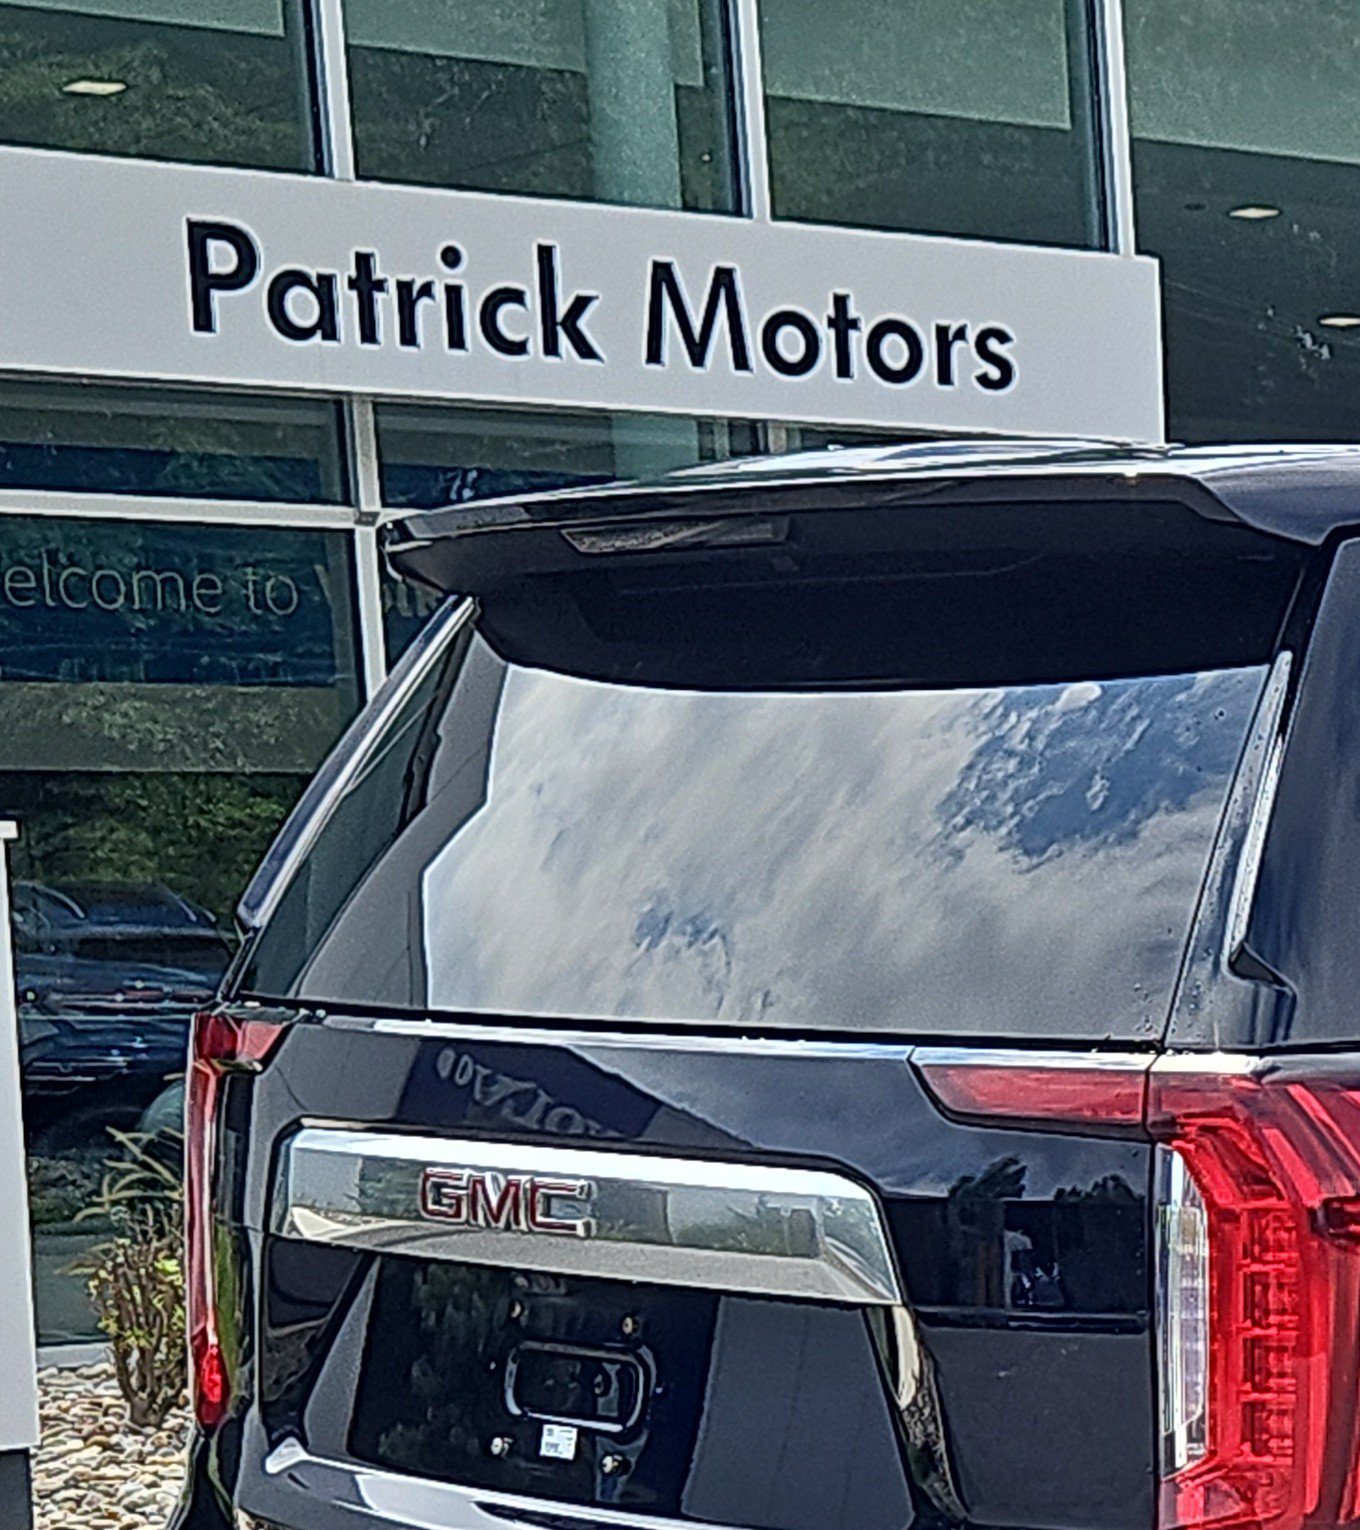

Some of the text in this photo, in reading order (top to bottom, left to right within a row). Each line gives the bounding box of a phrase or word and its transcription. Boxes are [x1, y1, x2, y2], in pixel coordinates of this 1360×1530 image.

[186, 216, 1018, 393] Patrick Motors
[246, 565, 298, 616] to
[416, 1167, 597, 1235] GMC
